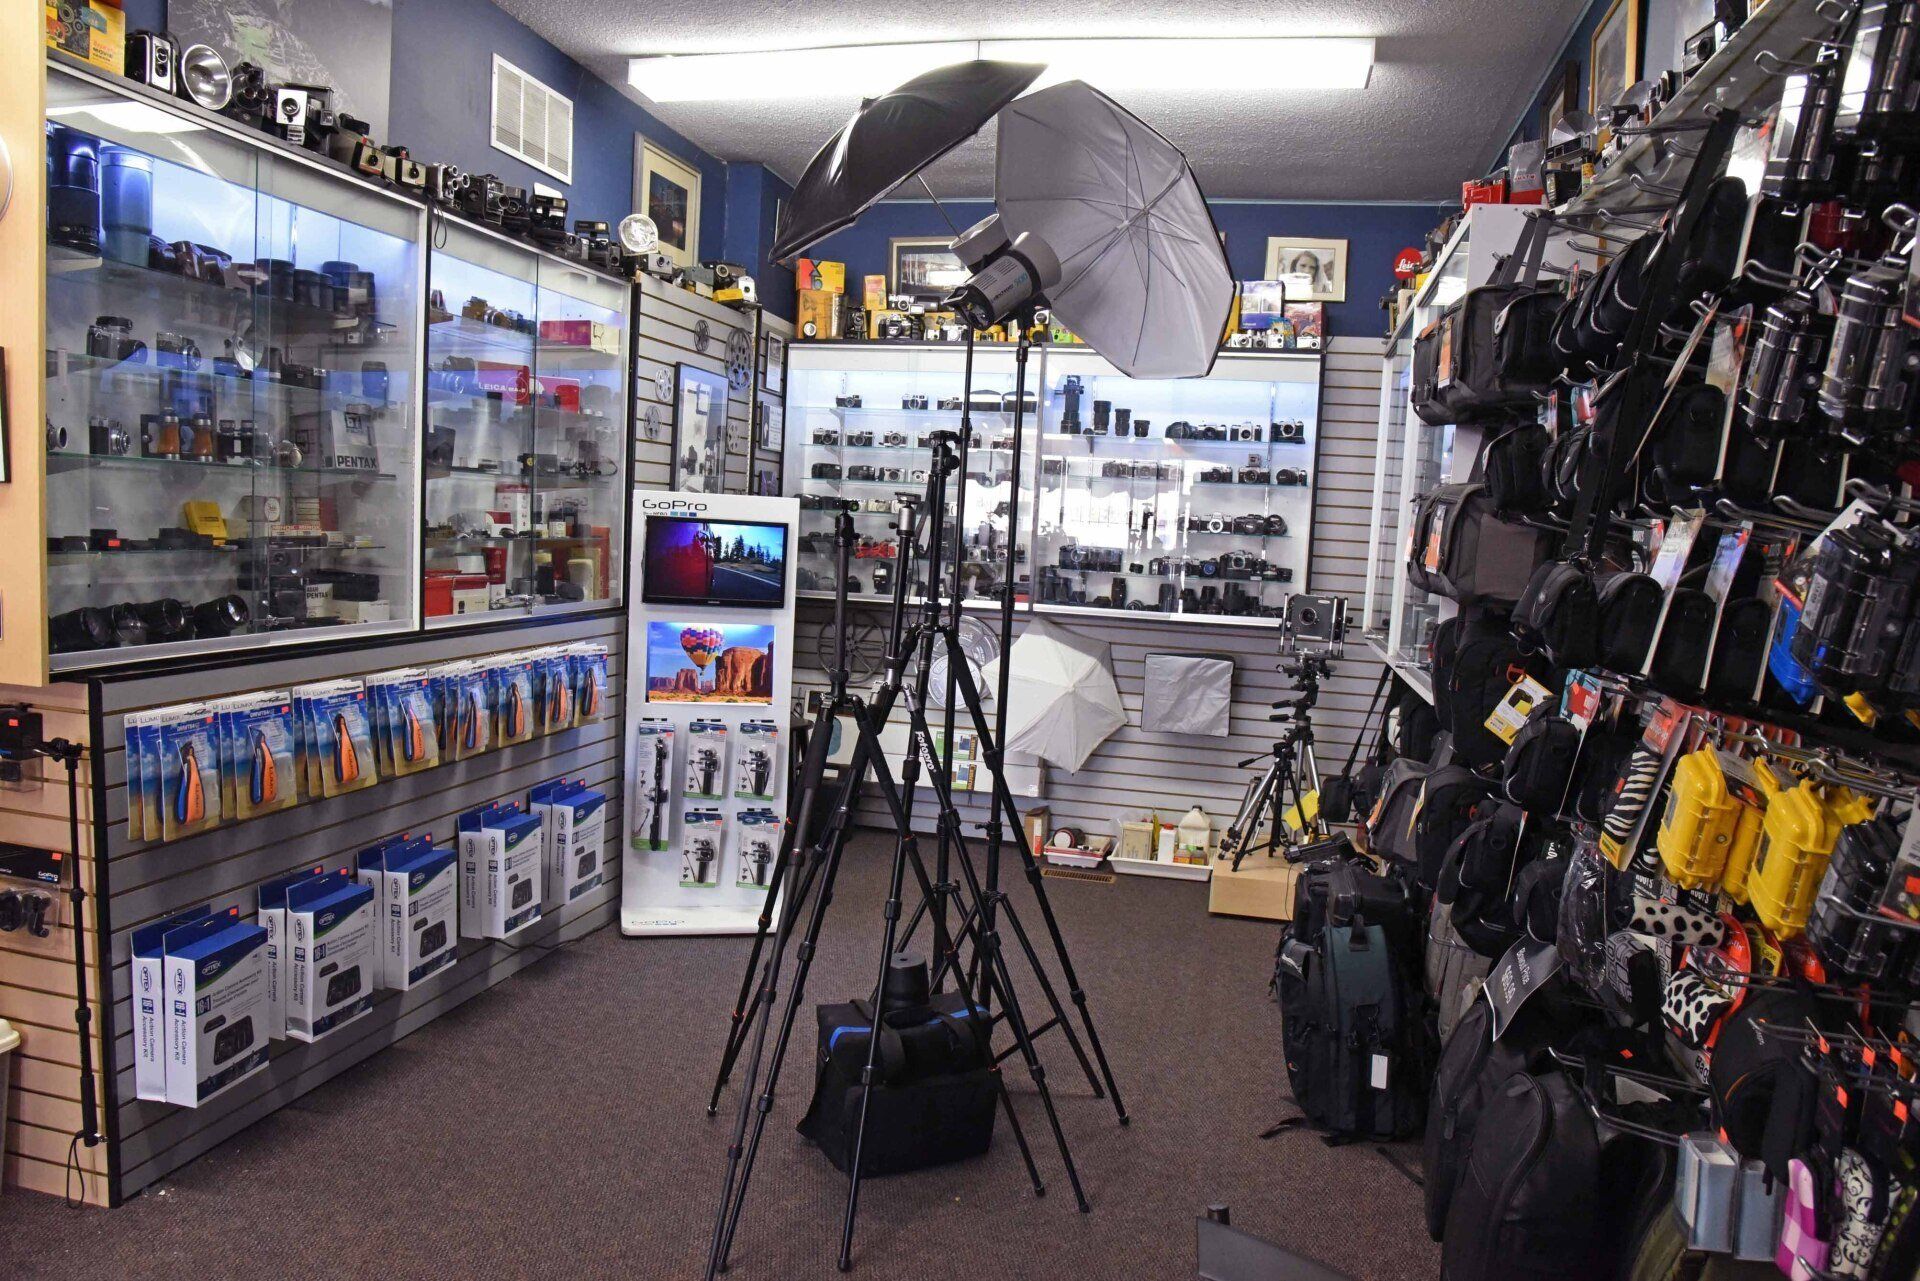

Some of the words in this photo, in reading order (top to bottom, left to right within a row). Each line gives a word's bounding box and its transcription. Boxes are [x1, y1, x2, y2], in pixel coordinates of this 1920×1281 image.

[478, 381, 506, 391] LEICA
[336, 455, 377, 469] PENTAX
[642, 499, 707, 511] GoPro
[232, 702, 252, 710] LUMIX
[161, 715, 181, 723] LUMIX
[915, 731, 934, 770] Fotopro
[201, 961, 221, 975] OPTEX
[142, 966, 150, 993] OPTEX
[175, 968, 183, 994] OPTEX
